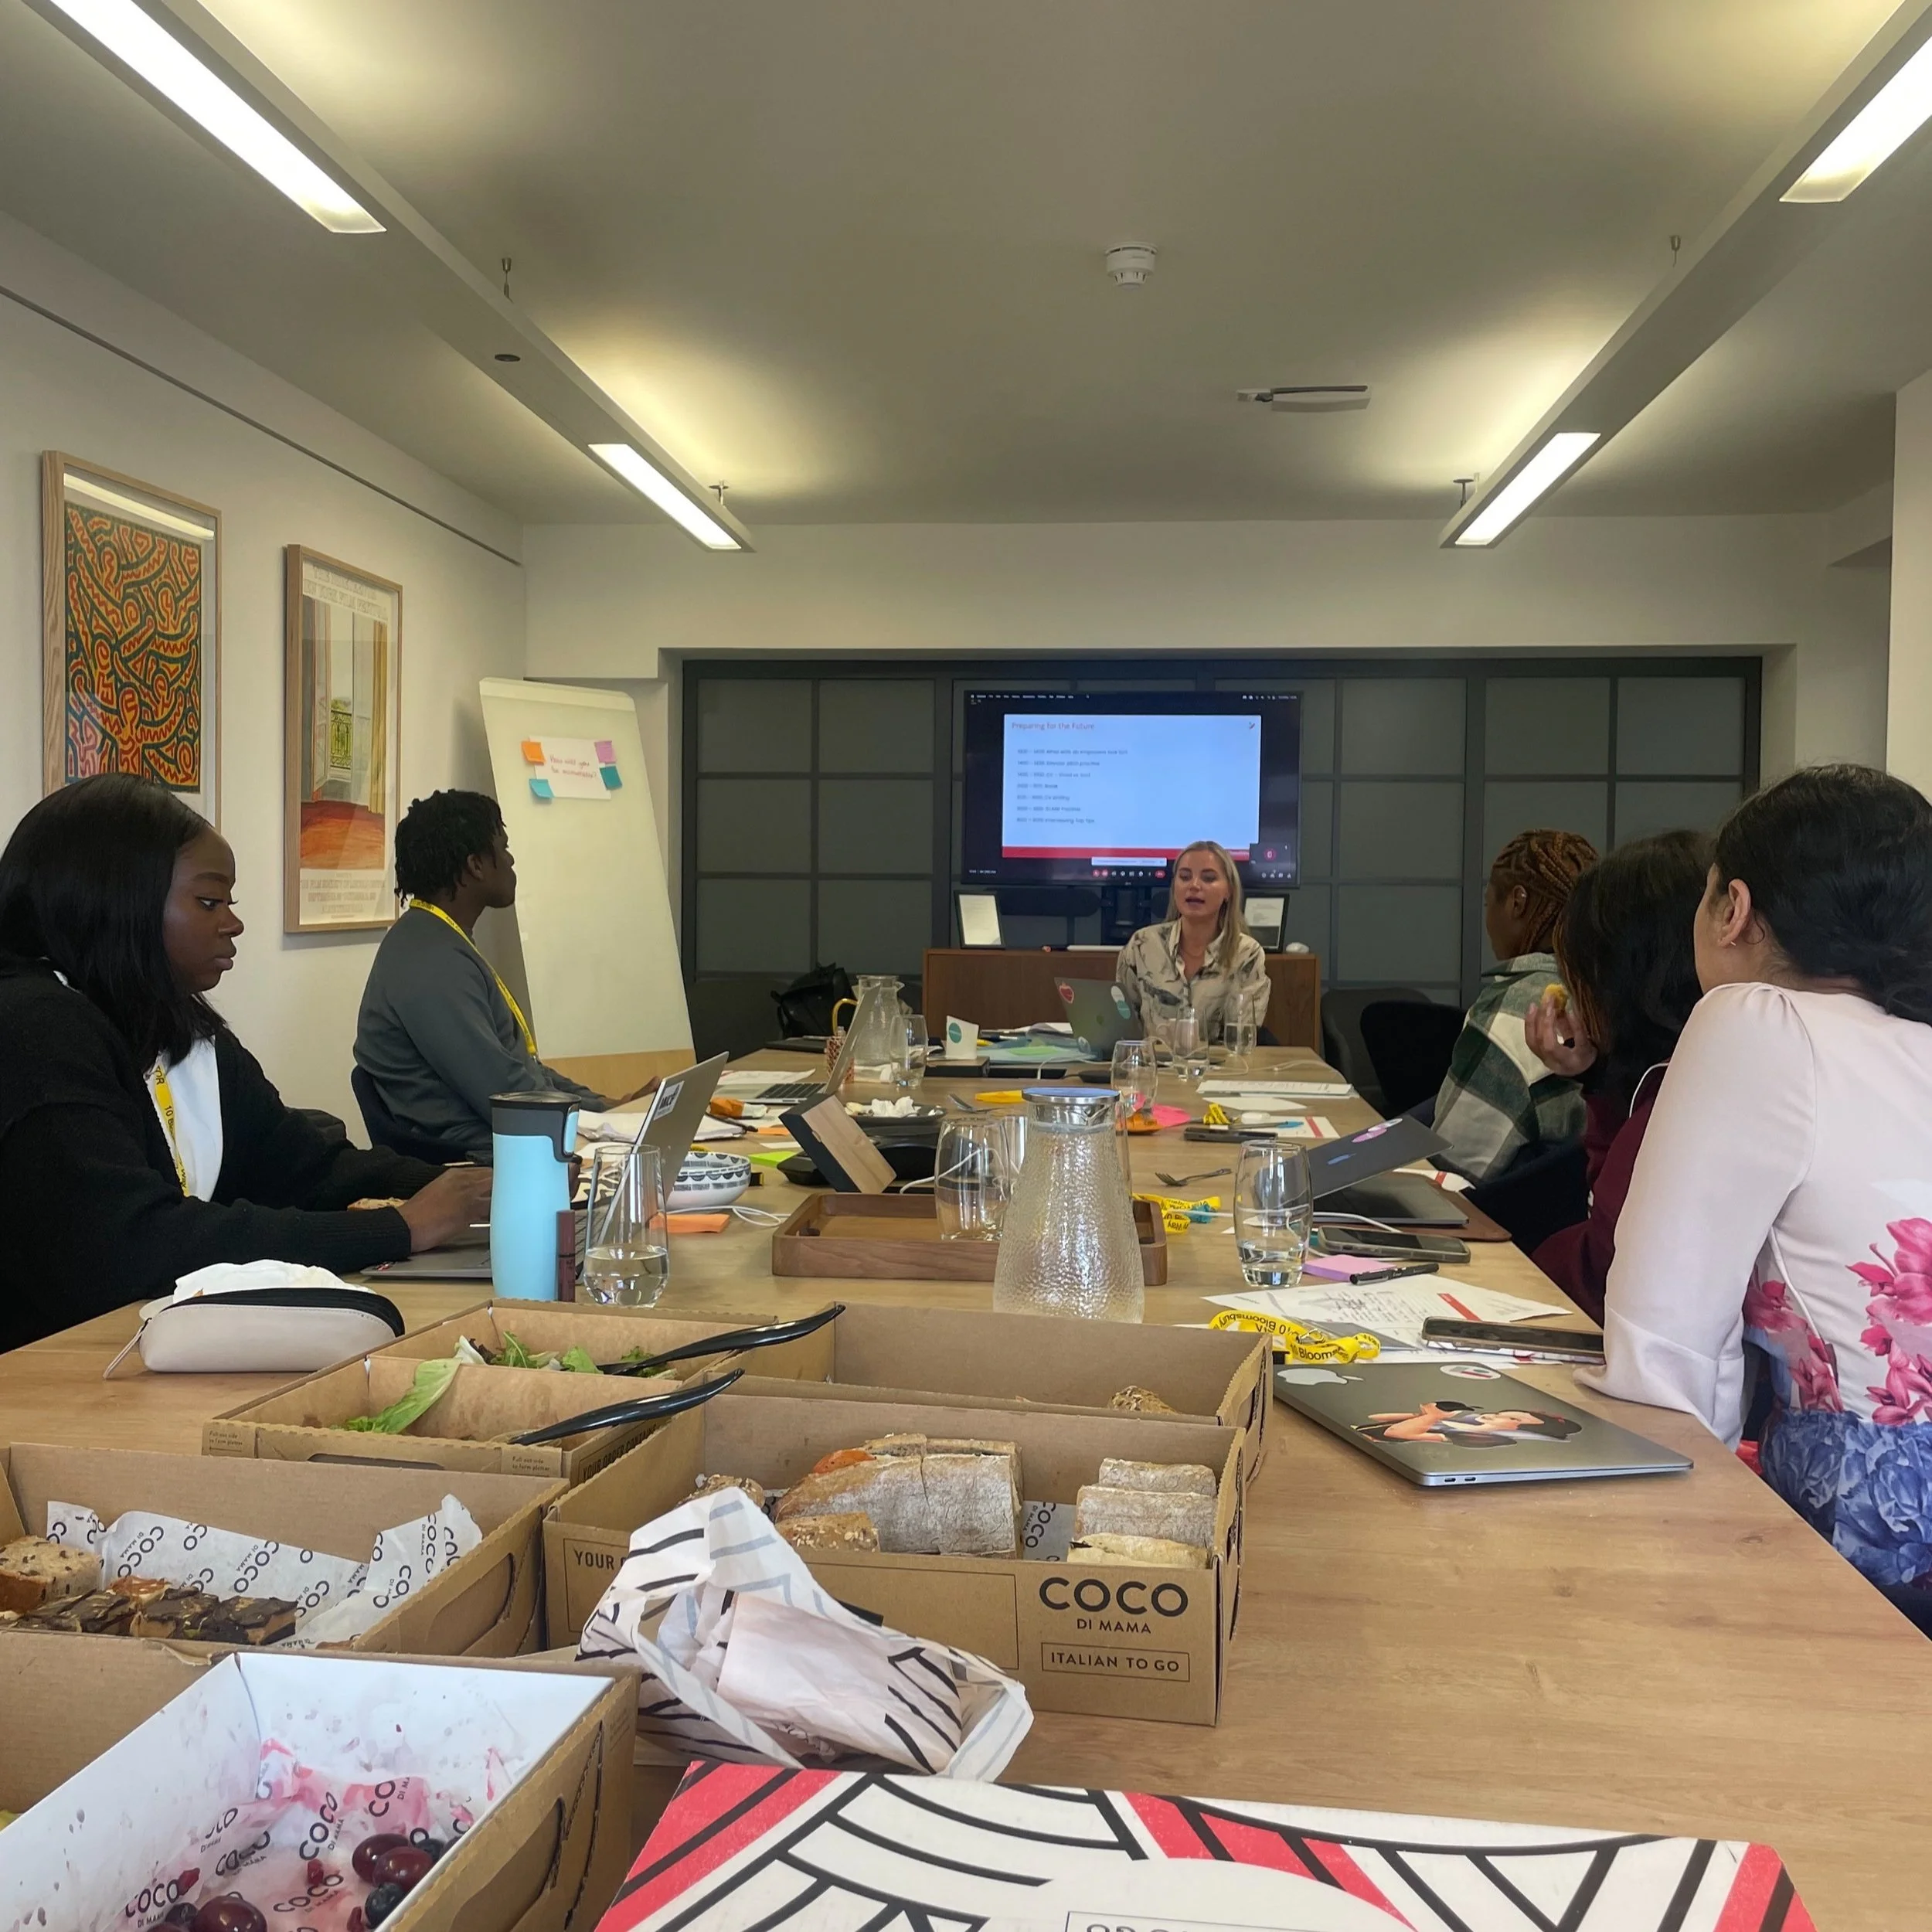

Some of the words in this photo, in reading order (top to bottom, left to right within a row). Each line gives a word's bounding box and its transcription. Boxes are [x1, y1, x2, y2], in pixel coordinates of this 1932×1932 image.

[165, 1105, 174, 1116] 10
[1219, 1313, 1276, 1330] Bloomsbury
[117, 1526, 164, 1578] COCO
[120, 1539, 138, 1559] MAMA
[573, 1549, 614, 1570] YOUR
[233, 1540, 279, 1594] COCO
[1039, 1577, 1189, 1617] COCO
[1077, 1618, 1092, 1630] DI
[1099, 1620, 1151, 1634] MAMA
[1051, 1651, 1118, 1668] ITALIAN
[1126, 1658, 1148, 1670] TO
[1154, 1660, 1179, 1672] GO
[299, 1791, 338, 1861] COCO
[273, 1873, 344, 1913] COCO
